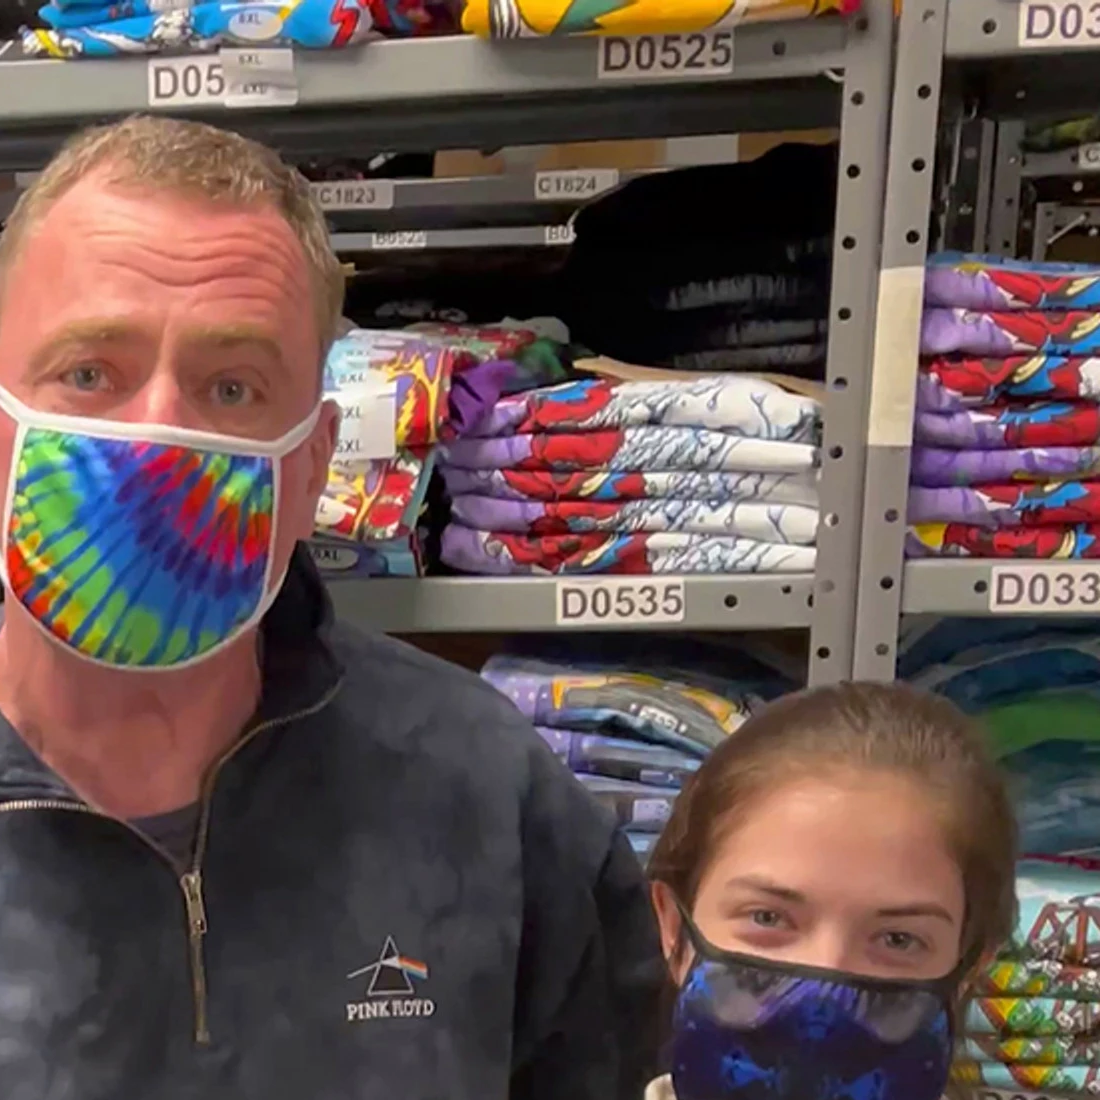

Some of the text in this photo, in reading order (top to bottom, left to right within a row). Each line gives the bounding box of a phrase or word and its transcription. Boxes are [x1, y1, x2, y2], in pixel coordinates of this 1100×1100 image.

[604, 33, 733, 71] D0525
[538, 176, 597, 194] C1824
[561, 584, 683, 619] D0535
[996, 572, 1100, 605] D033
[346, 998, 435, 1021] PINK FLOYD
